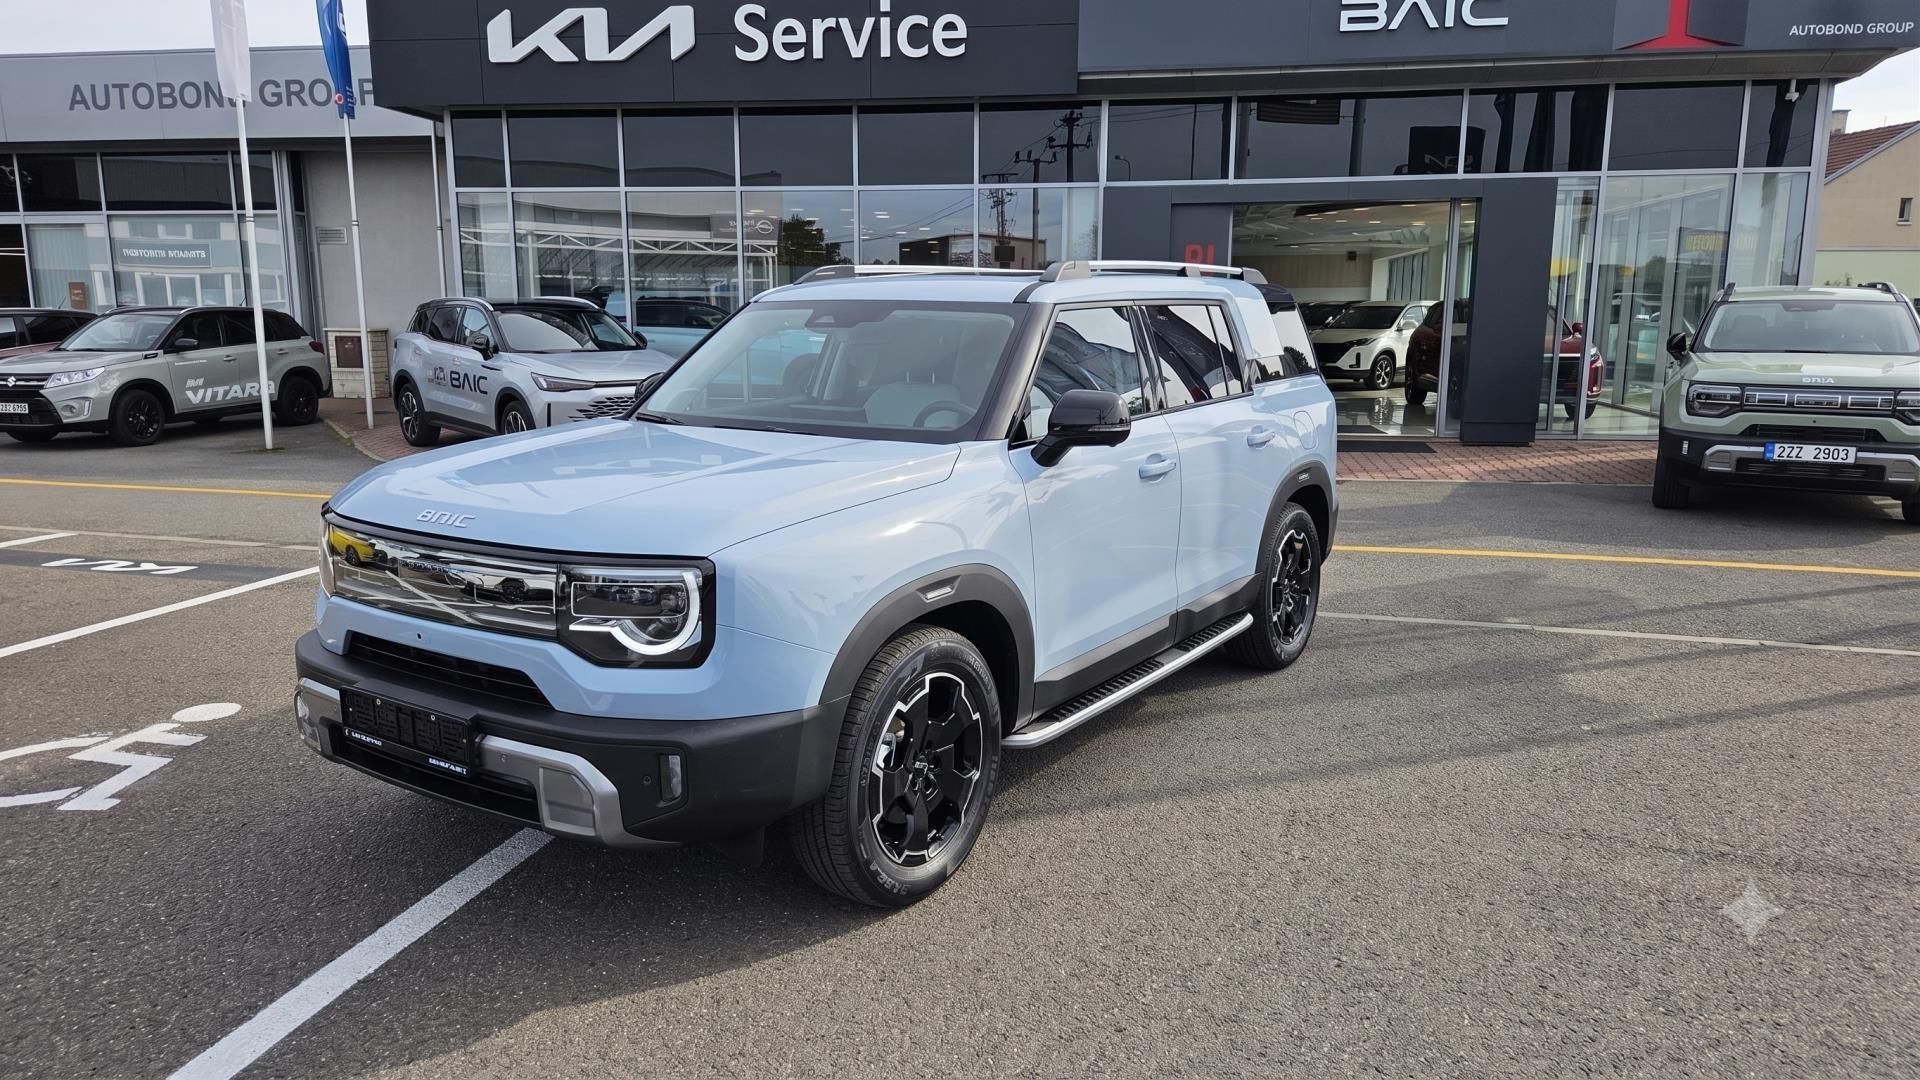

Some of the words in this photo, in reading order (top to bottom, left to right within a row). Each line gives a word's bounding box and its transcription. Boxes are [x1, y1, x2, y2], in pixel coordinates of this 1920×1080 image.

[1339, 0, 1509, 32] BAIC
[1789, 23, 1863, 36] AUTOBOND
[1867, 21, 1915, 34] GROUP
[487, 5, 695, 63] KIA
[734, 0, 967, 62] Service
[68, 81, 246, 111] AUTOBON
[258, 78, 375, 107] GROP
[449, 370, 488, 395] BAIC
[1777, 445, 1804, 459] 2ZZ
[1813, 447, 1850, 461] 2903
